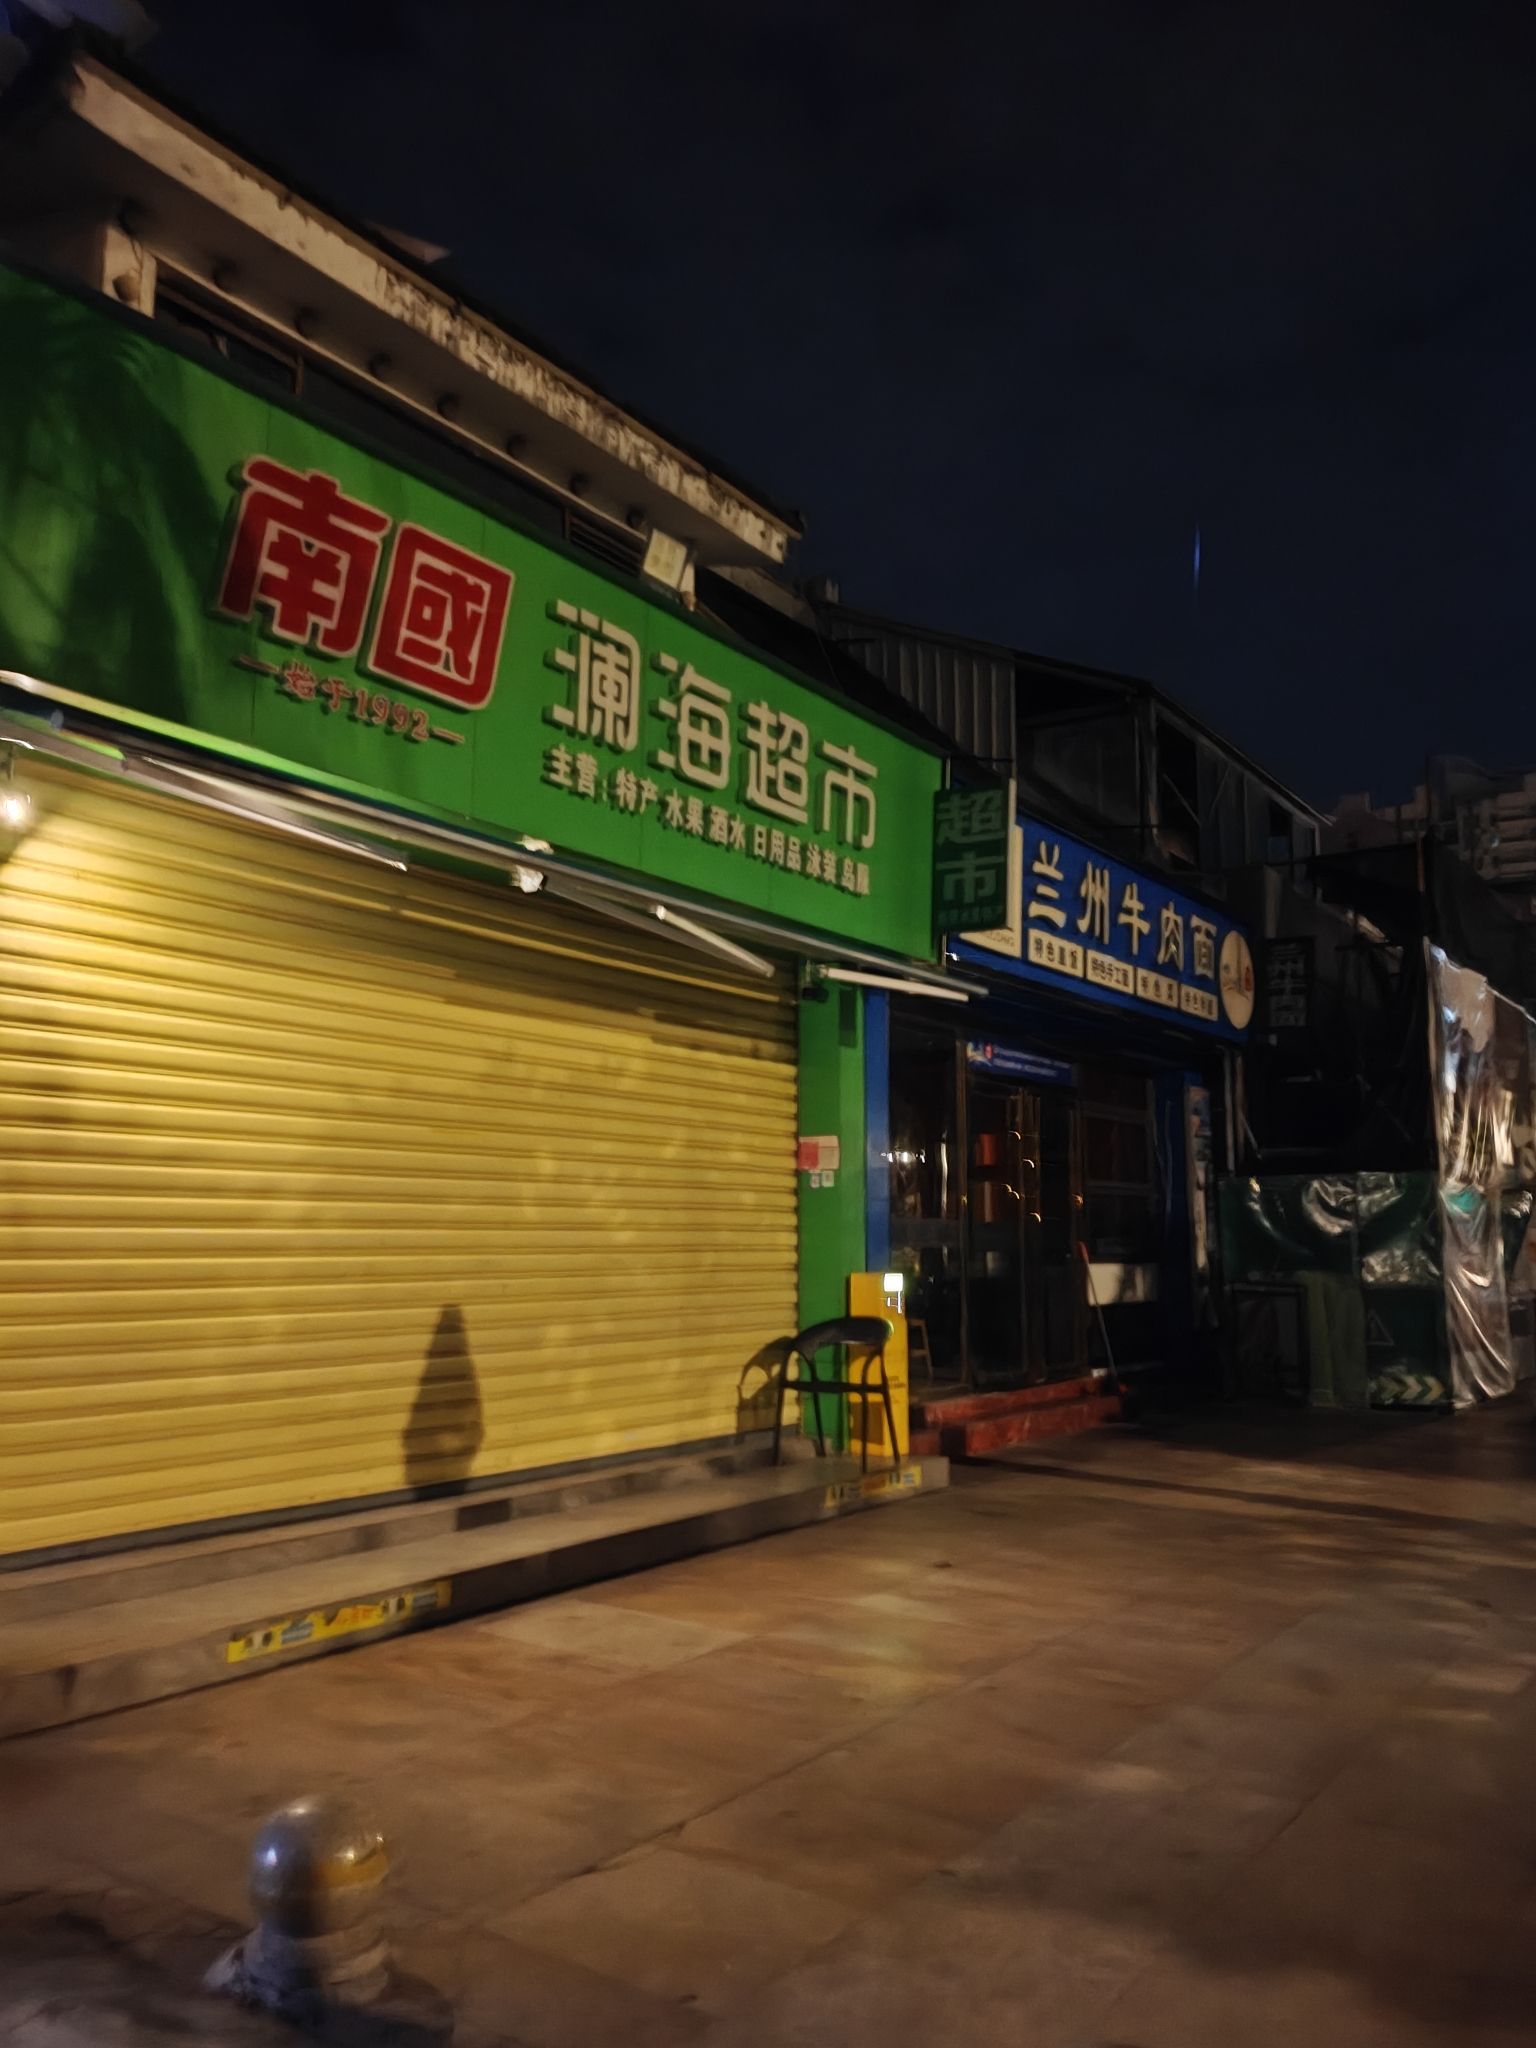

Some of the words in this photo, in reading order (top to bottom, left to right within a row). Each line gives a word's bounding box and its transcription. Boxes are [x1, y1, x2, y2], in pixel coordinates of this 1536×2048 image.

[219, 453, 516, 712] 南國
[553, 598, 880, 849] 澜海超市
[664, 787, 705, 837] 水果
[753, 823, 802, 872] 日用品
[936, 789, 1006, 904] 超市
[1027, 839, 1218, 981] 兰州牛肉面
